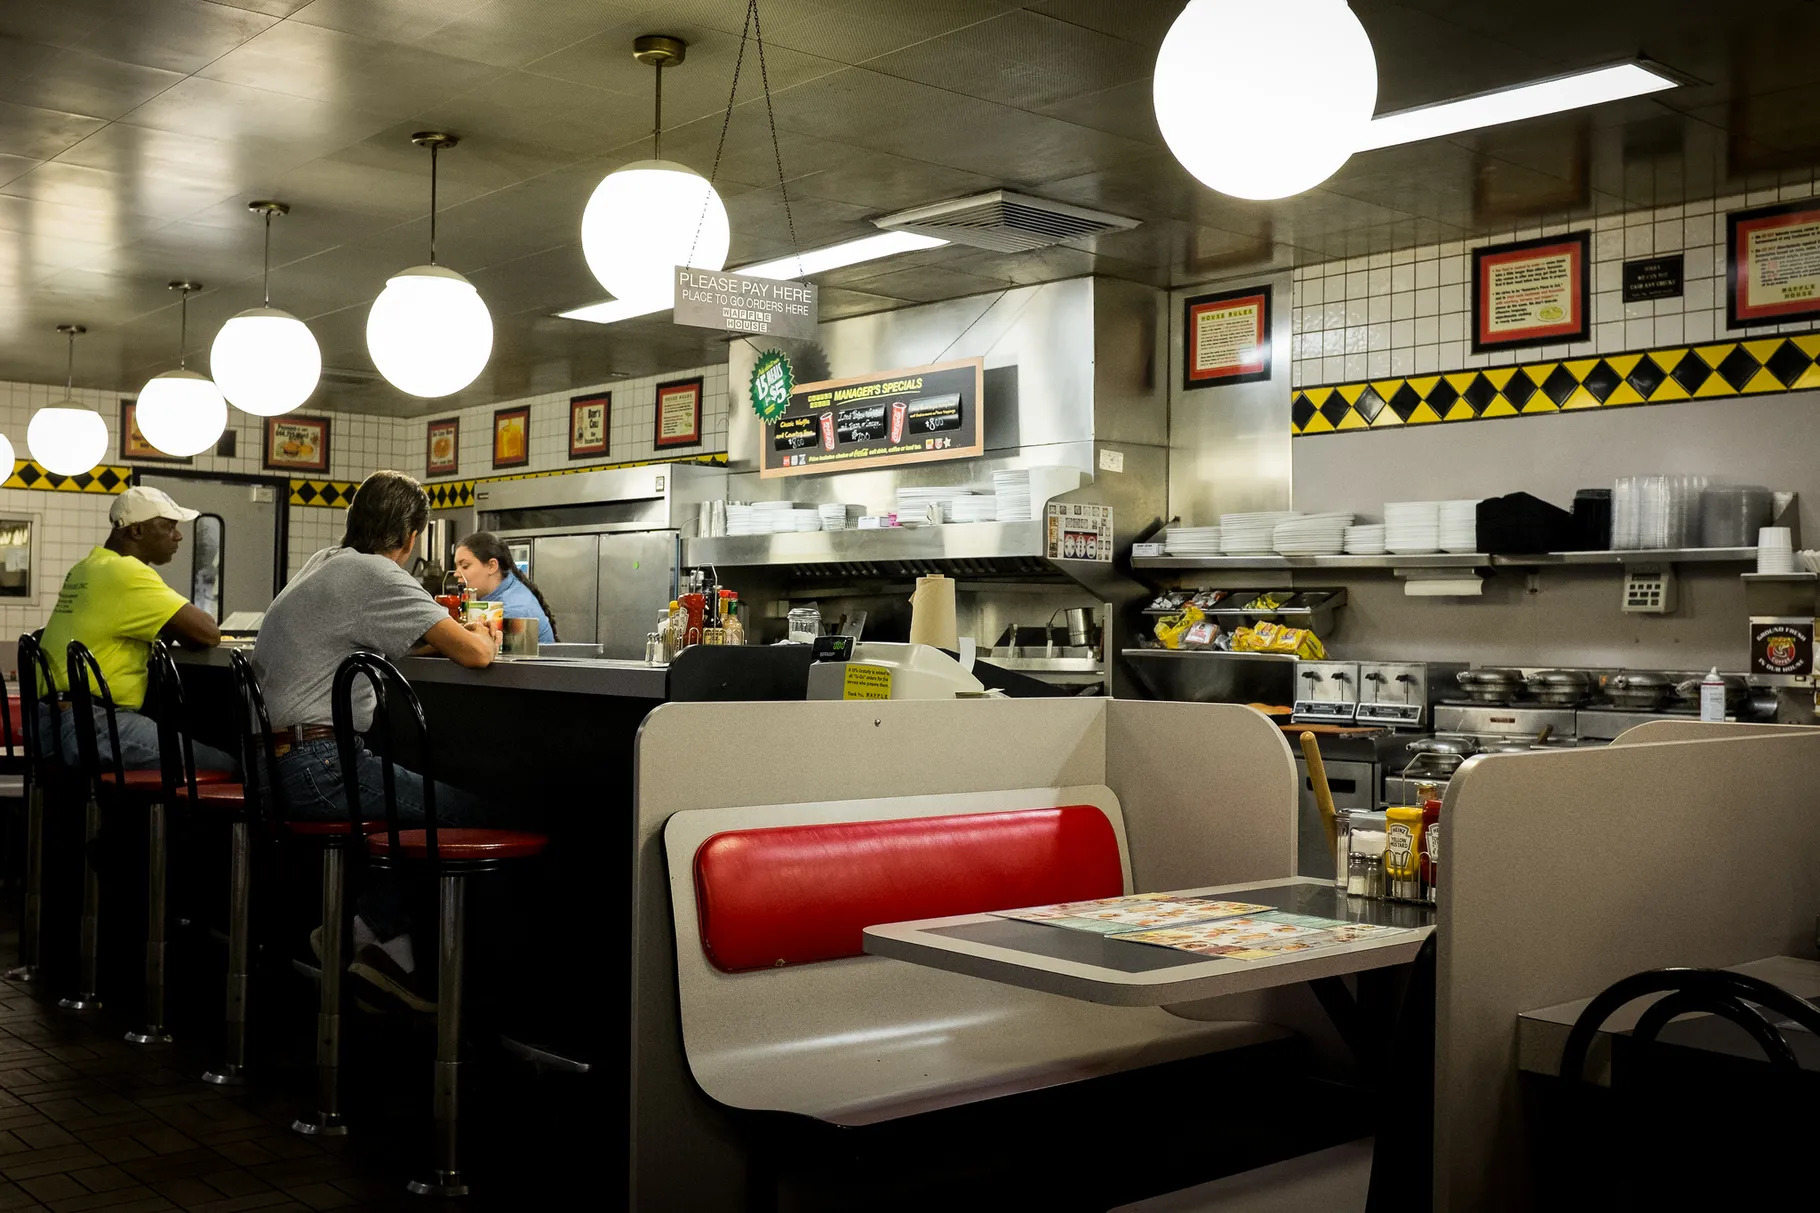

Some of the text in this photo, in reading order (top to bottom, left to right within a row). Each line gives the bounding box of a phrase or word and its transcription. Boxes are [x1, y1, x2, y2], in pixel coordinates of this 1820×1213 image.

[680, 272, 812, 304] PLEASE PAY HERE
[682, 289, 809, 316] PLACE TO GO ORDERS HERE
[723, 308, 772, 323] WAFFLE
[1201, 309, 1253, 321] HOUSE RULES
[727, 319, 768, 333] HOUSE
[756, 374, 769, 401] 15
[770, 379, 787, 404] $5
[834, 385, 881, 401] MANAGER'S
[882, 378, 923, 394] SPECIALS
[1757, 627, 1807, 641] GROUND FRESH
[1759, 658, 1766, 666] IN
[1782, 658, 1804, 672] HOUSE
